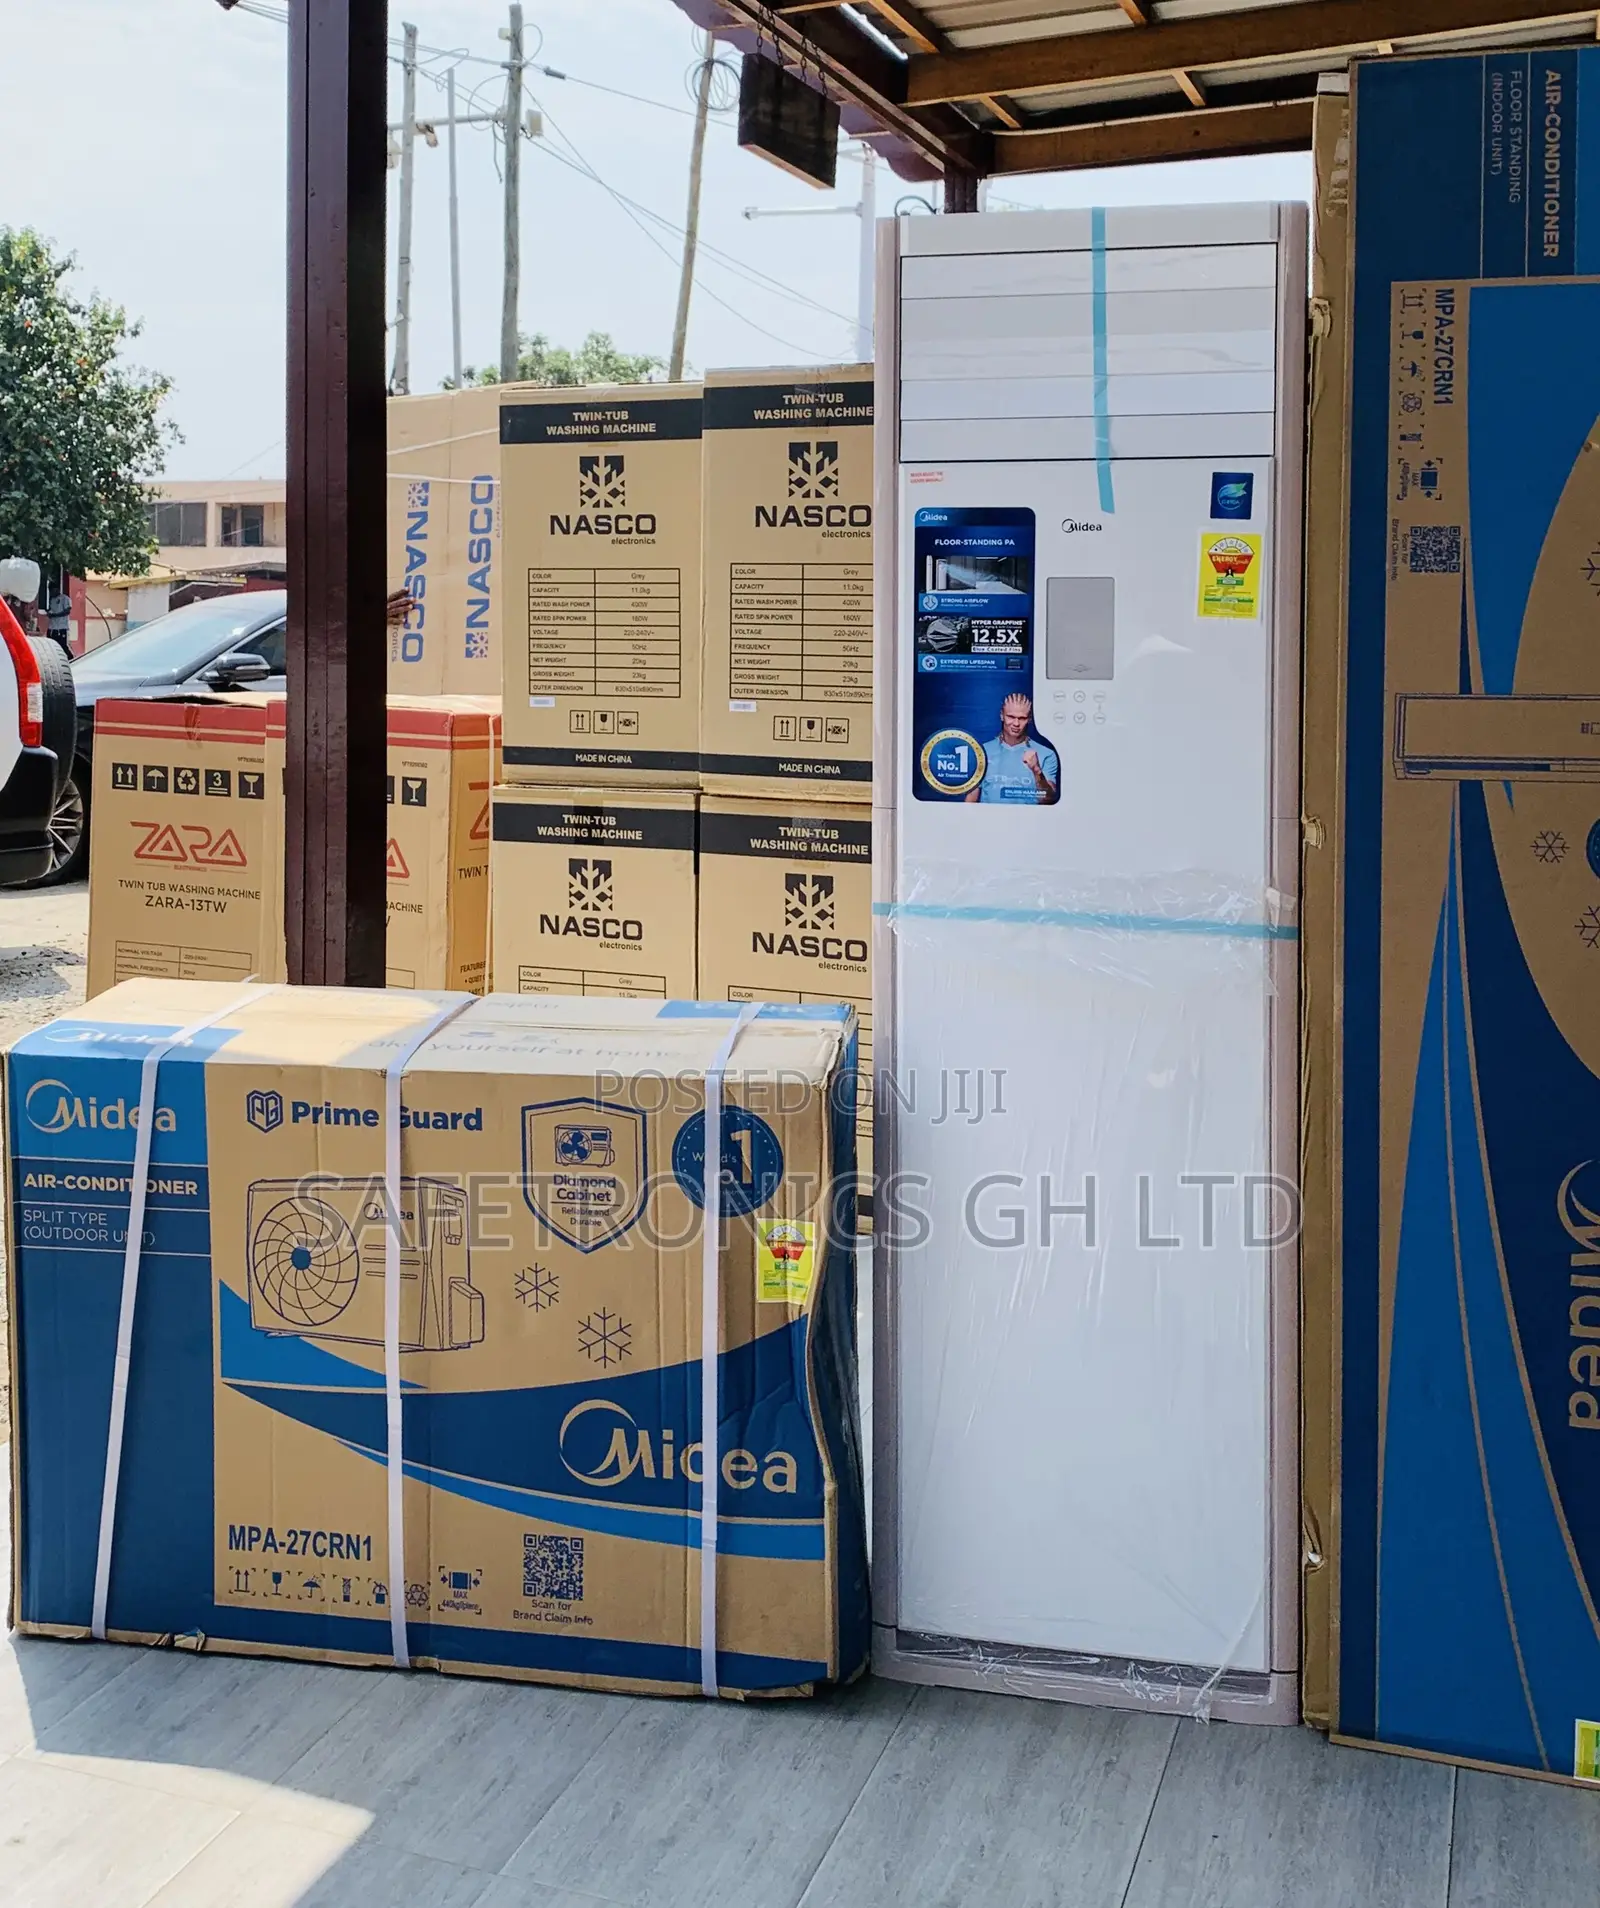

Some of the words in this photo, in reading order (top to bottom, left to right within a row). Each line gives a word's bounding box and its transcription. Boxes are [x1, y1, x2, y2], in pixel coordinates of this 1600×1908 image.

[1491, 72, 1504, 133] (INDOOR
[1509, 70, 1523, 123] FLOOR
[1490, 137, 1503, 176] UNIT)
[1508, 126, 1522, 204] STANDING
[1543, 70, 1562, 258] AIR-CONDITIONER
[1433, 288, 1455, 405] MPA-27CRN1
[783, 393, 844, 405] TWIN-TUB
[572, 410, 629, 422] TWIN-TUB
[754, 408, 813, 420] WASHING
[815, 406, 874, 418] MACHINE
[546, 424, 600, 436] WASHING
[602, 422, 657, 434] MACHINE
[549, 513, 657, 536] NASCO
[755, 505, 872, 528] NASCO
[919, 510, 948, 522] Midea
[1061, 517, 1103, 534] Midea
[610, 536, 656, 546] electronics
[821, 530, 871, 539] electronics
[934, 538, 1003, 546] FLOOR-STANDING
[1004, 538, 1016, 546] PA
[464, 474, 494, 629] NASCO
[402, 511, 428, 663] NASCO
[575, 754, 597, 763] MADE
[598, 754, 607, 763] IN
[607, 754, 633, 764] CHINA
[937, 760, 959, 770] No.
[954, 745, 969, 773] 1
[779, 763, 801, 774] MADE
[803, 764, 812, 774] IN
[814, 764, 841, 775] CHINA
[562, 813, 617, 826] TWIN-TUB
[536, 825, 589, 838] WASHING
[590, 827, 643, 840] MACHINE
[778, 826, 839, 840] TWIN-TUB
[130, 821, 248, 867] ZARA
[750, 838, 808, 852] WASHING
[810, 841, 869, 856] MACHINE
[457, 866, 483, 880] TWIN
[118, 879, 145, 890] TWIN
[146, 881, 167, 892] TUB
[168, 883, 216, 896] WASHING
[217, 886, 262, 900] MACHINE
[145, 894, 228, 914] ZARA-13TW
[386, 900, 424, 914] ACHINE
[539, 913, 643, 941] NASCO
[599, 940, 643, 951] electronics
[752, 931, 868, 962] NASCO
[818, 961, 868, 973] electronics
[522, 985, 549, 993] CAPACITY
[45, 1027, 194, 1047] Mida
[291, 1100, 380, 1127] Prime
[692, 1150, 737, 1164] Wd's
[24, 1173, 198, 1196] AIR-CONDITONER
[553, 1174, 616, 1188] Diamond
[557, 1187, 611, 1202] Cabinet
[23, 1209, 64, 1224] SPLIT
[68, 1211, 108, 1226] TYPE
[23, 1226, 109, 1242] (OUTDOOR
[113, 1230, 156, 1247] UT)
[228, 1525, 373, 1561] MPA-27CRN1
[531, 1599, 556, 1610] Scan
[557, 1600, 573, 1611] for
[512, 1609, 542, 1622] Brand
[544, 1612, 573, 1624] Claim
[574, 1614, 595, 1626] Info
